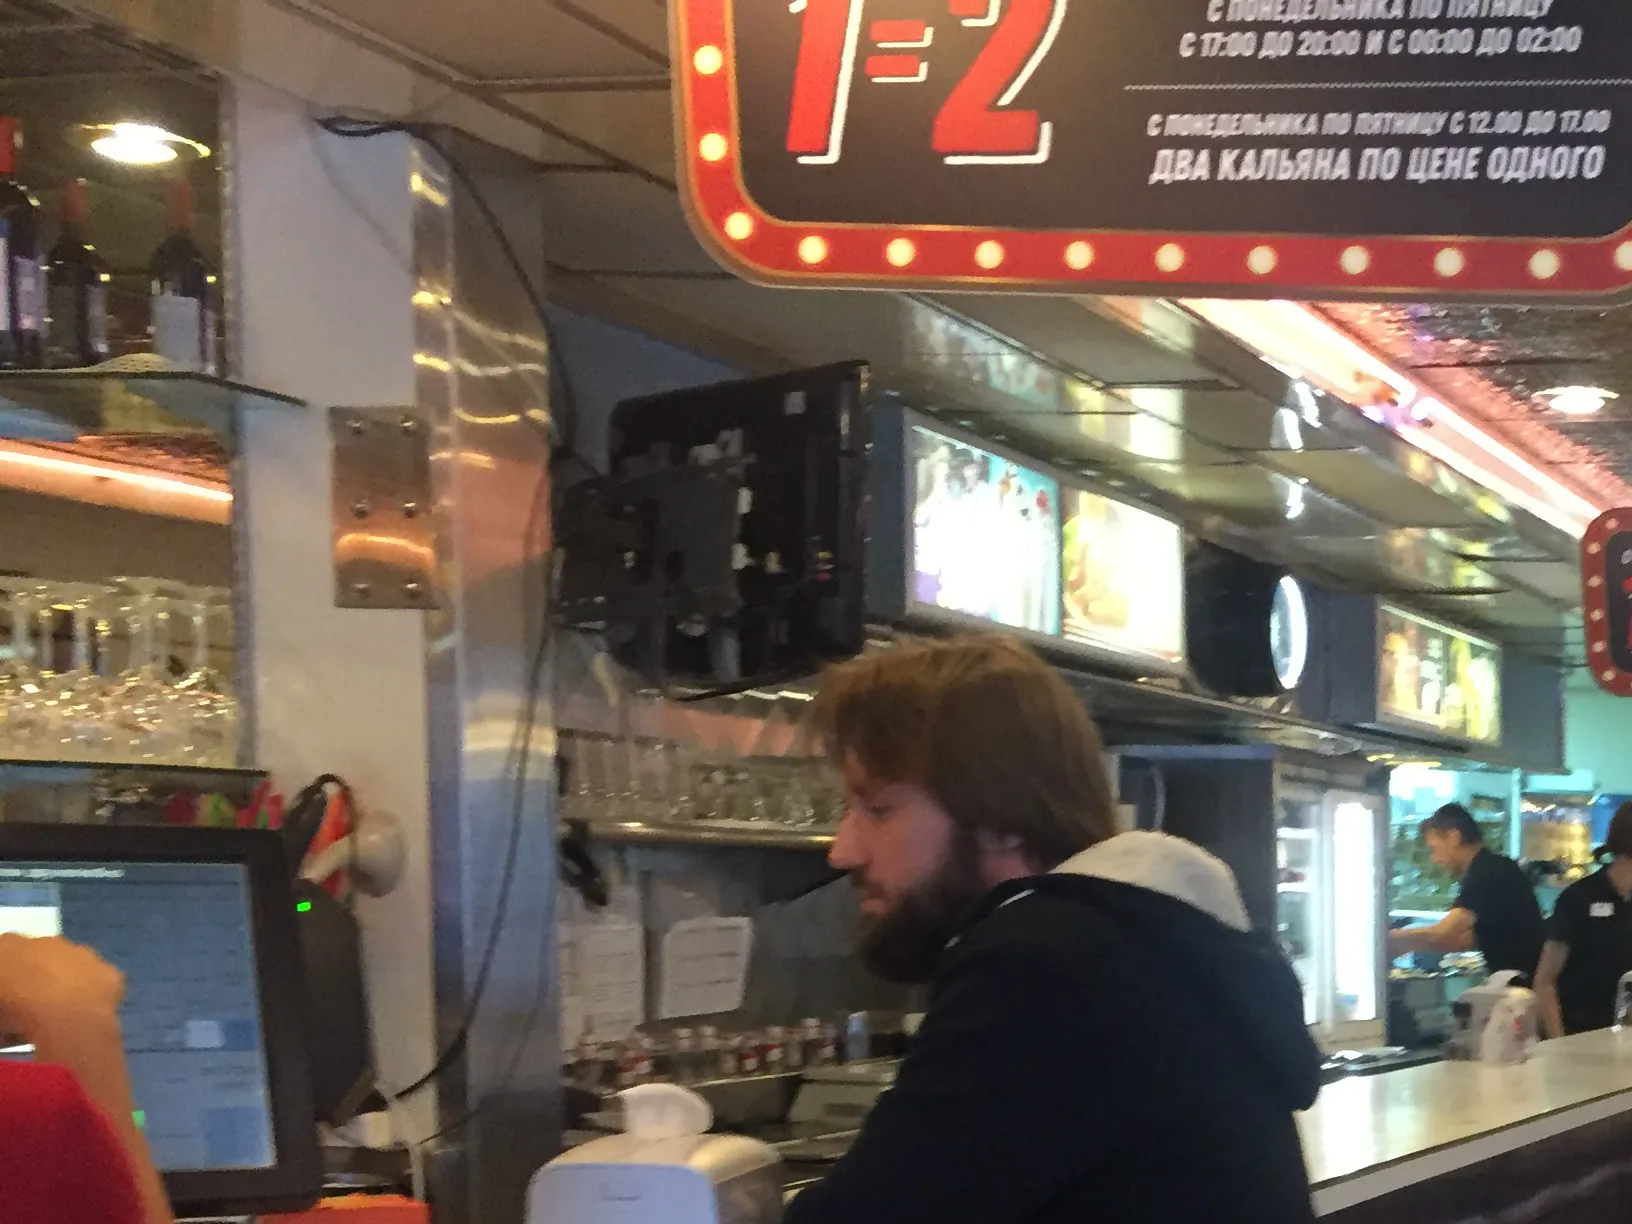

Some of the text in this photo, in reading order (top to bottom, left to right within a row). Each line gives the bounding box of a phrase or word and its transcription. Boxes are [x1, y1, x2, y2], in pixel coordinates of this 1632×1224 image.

[1178, 32, 1197, 58] С
[1257, 30, 1294, 59] ДО
[1363, 29, 1386, 55] И
[1387, 28, 1406, 55] С
[1475, 26, 1513, 57] ДО
[786, 0, 1067, 165] 1=2
[1147, 113, 1164, 136] С
[1164, 112, 1319, 139] ПОНЕДЕЛЬНИКА
[1321, 112, 1352, 136] ПО
[1354, 111, 1449, 136] ПЯТНИЦУ
[1449, 110, 1466, 134] С
[1522, 108, 1557, 136] ДО
[1148, 145, 1607, 185] ДВА КАЛЬЯНА ПО ЦЕНЕ ОДНОГО
